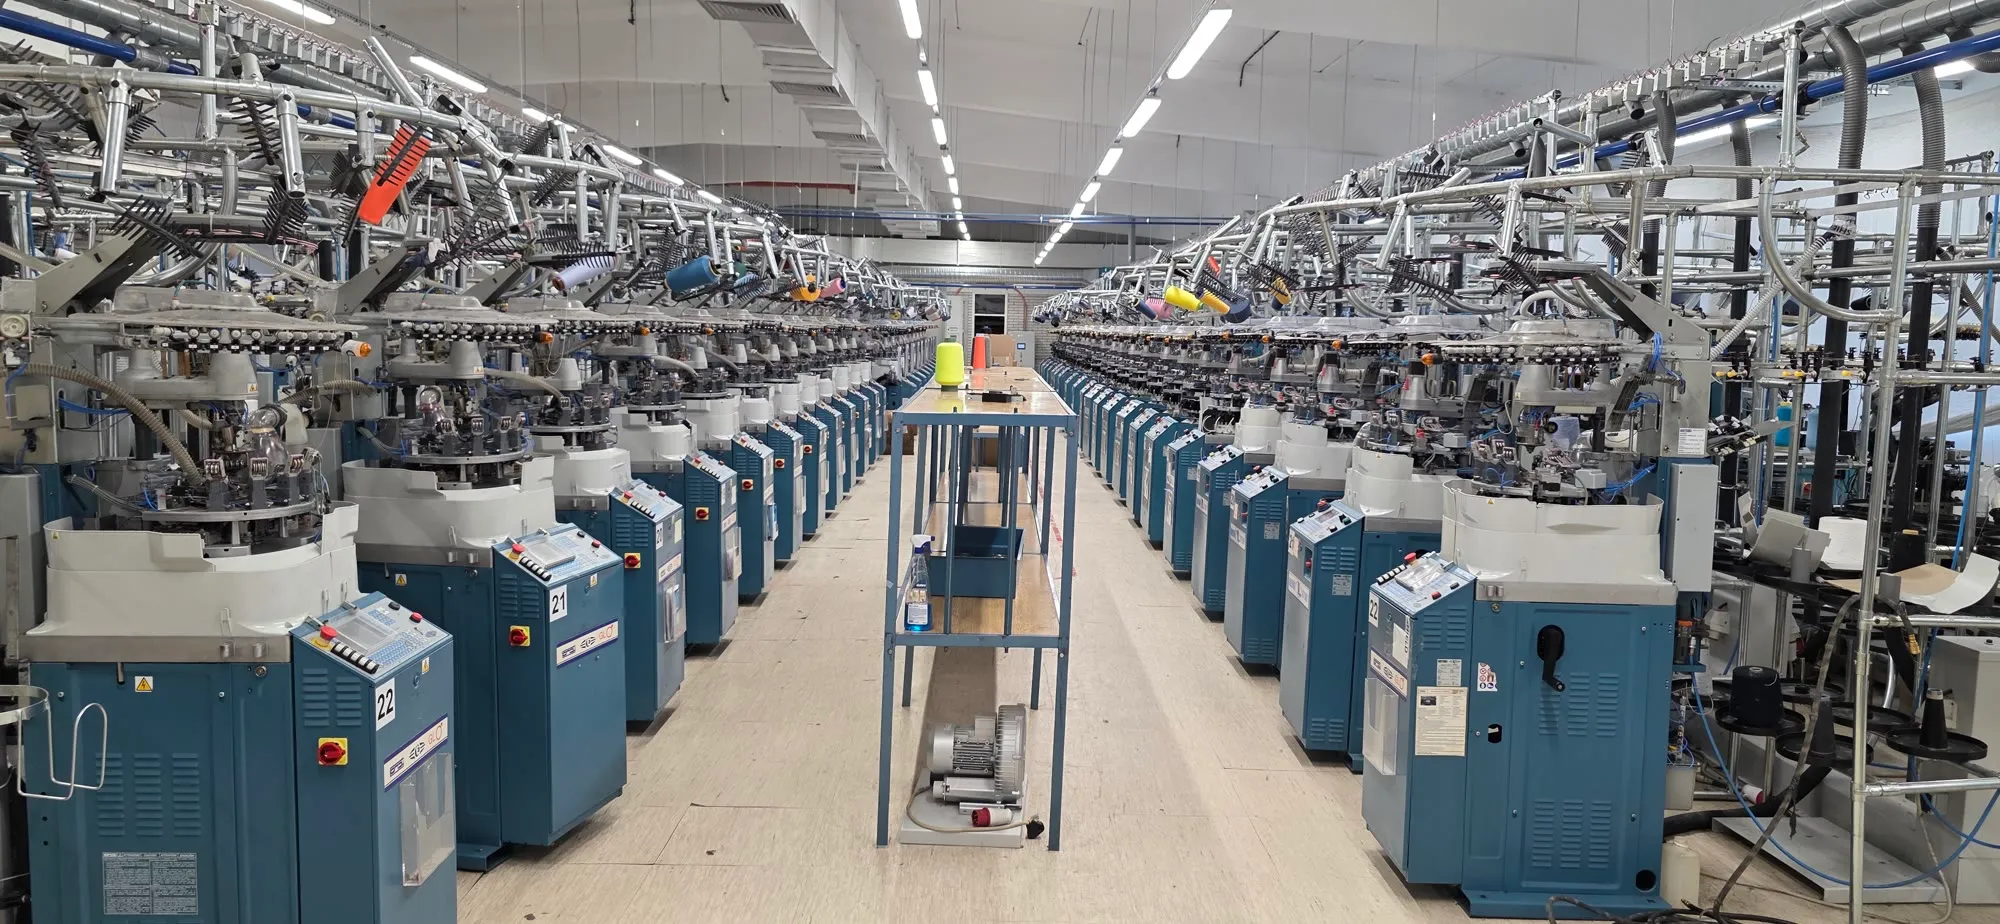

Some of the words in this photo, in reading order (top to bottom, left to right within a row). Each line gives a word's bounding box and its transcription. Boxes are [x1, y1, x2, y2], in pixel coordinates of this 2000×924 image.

[552, 591, 565, 614] 21
[1369, 599, 1378, 621] 22
[377, 688, 394, 721] 22
